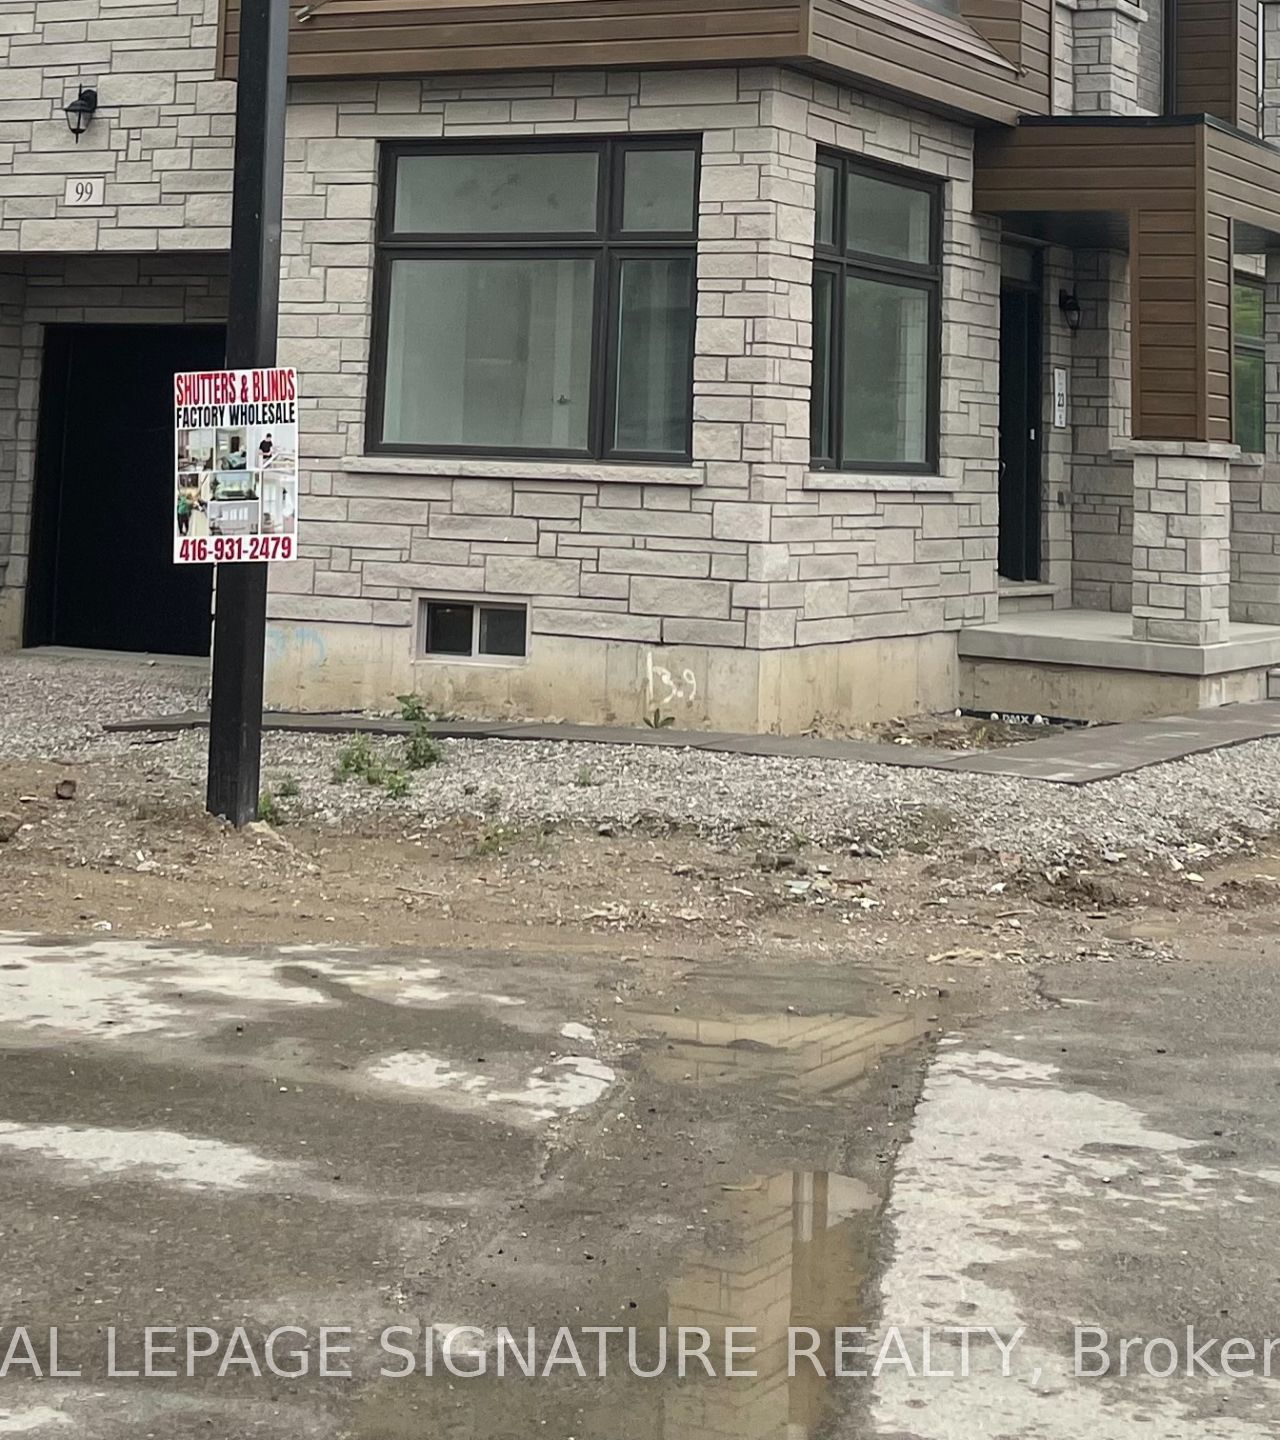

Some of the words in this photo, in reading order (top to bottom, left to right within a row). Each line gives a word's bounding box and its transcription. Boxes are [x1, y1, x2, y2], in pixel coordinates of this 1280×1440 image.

[75, 181, 94, 203] 99
[176, 372, 236, 406] SHUTTERS
[240, 374, 249, 403] &
[252, 368, 295, 402] BLINDS
[176, 405, 226, 429] FACTORY
[229, 402, 295, 426] WHOLESALE
[179, 536, 292, 561] 416-931-2479
